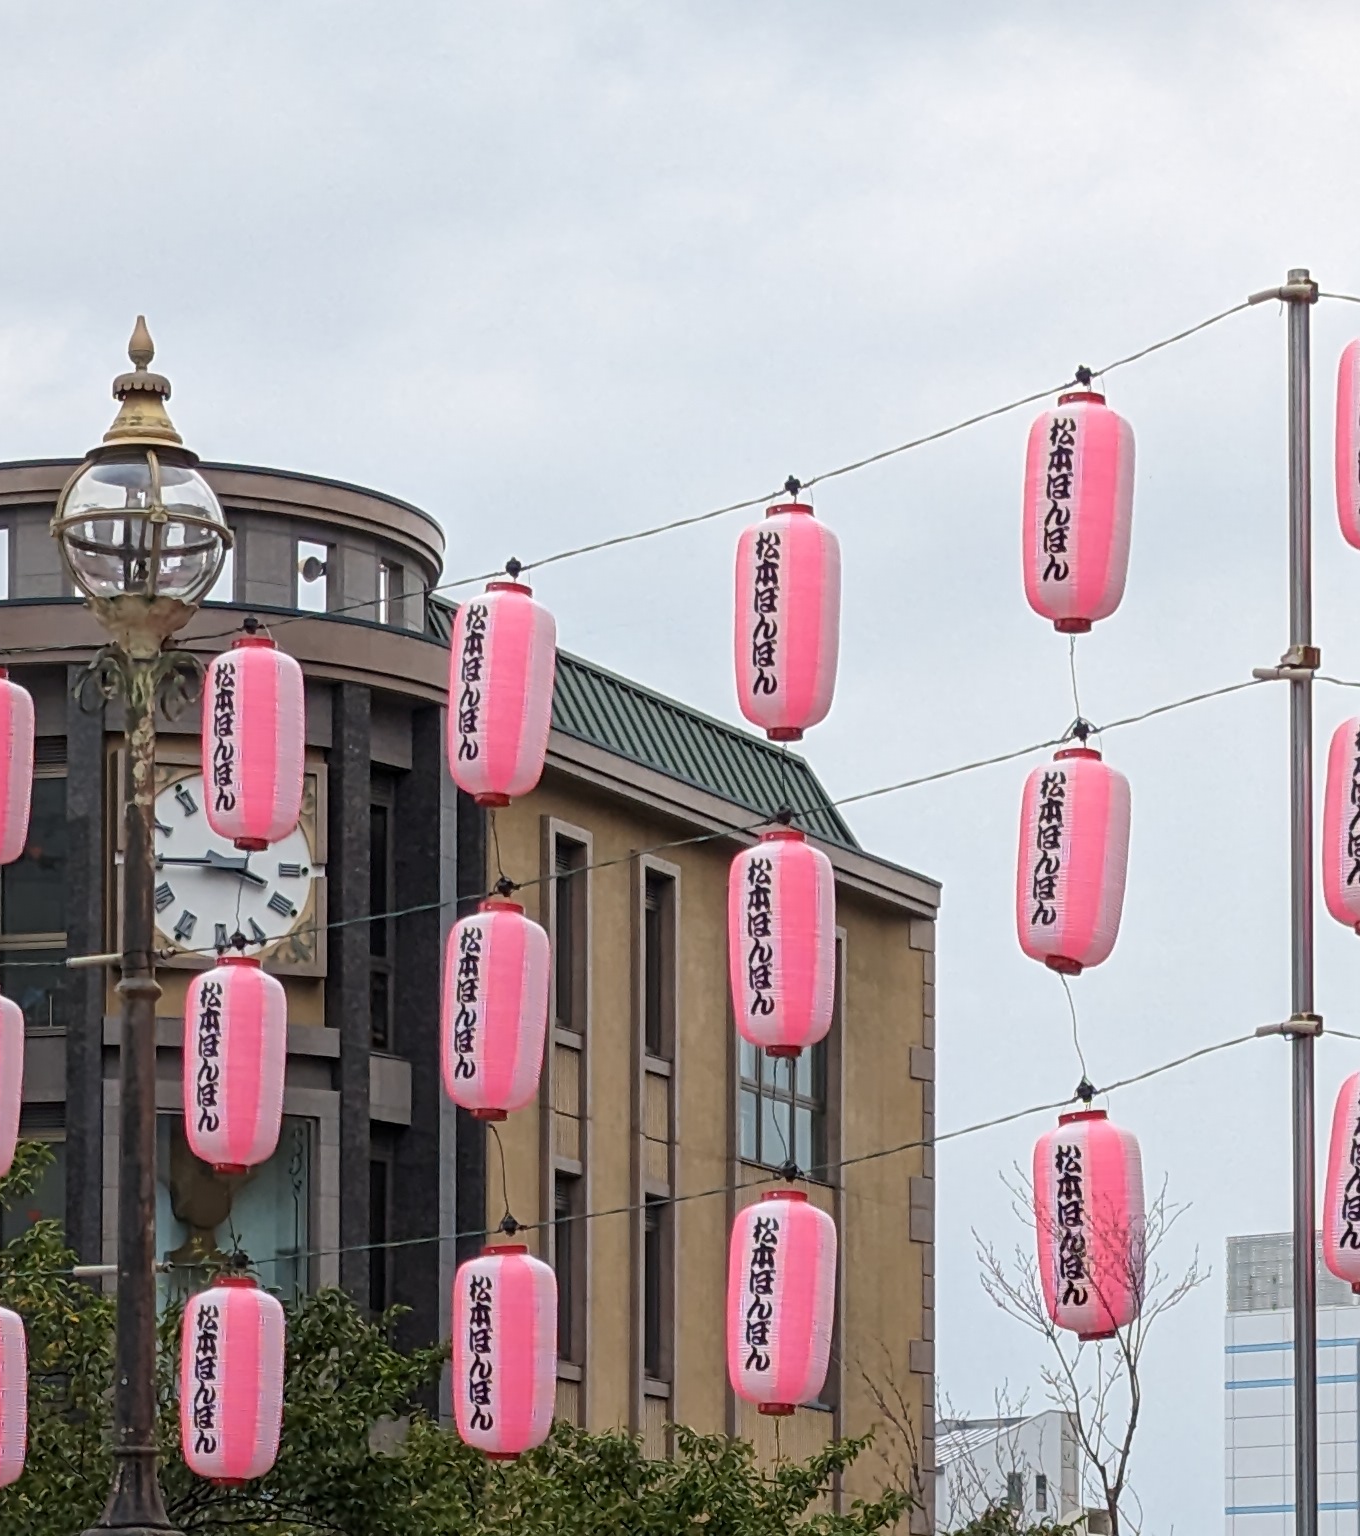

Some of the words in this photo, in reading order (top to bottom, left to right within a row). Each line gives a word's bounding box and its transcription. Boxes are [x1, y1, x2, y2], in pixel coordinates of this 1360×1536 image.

[1042, 418, 1077, 582] 松本ぼんぼん
[458, 605, 488, 761] 松本ぼんぼん
[752, 531, 781, 695] 松本ぼんぼん
[213, 663, 236, 812] 松本ぼんぼん
[1031, 771, 1067, 926] 松本ぼんぼん
[453, 927, 483, 1080] 松本ぼんぼん
[747, 858, 775, 1016] 松本ぼんぼん
[196, 982, 223, 1133] 松本ぼんぼん
[745, 1216, 779, 1372] 松本ぼんぼん
[1054, 1144, 1089, 1307] 松本ぼんぼん
[193, 1304, 219, 1454] 松本ぼんぼん
[468, 1274, 494, 1431] 松本ぼんぼん
